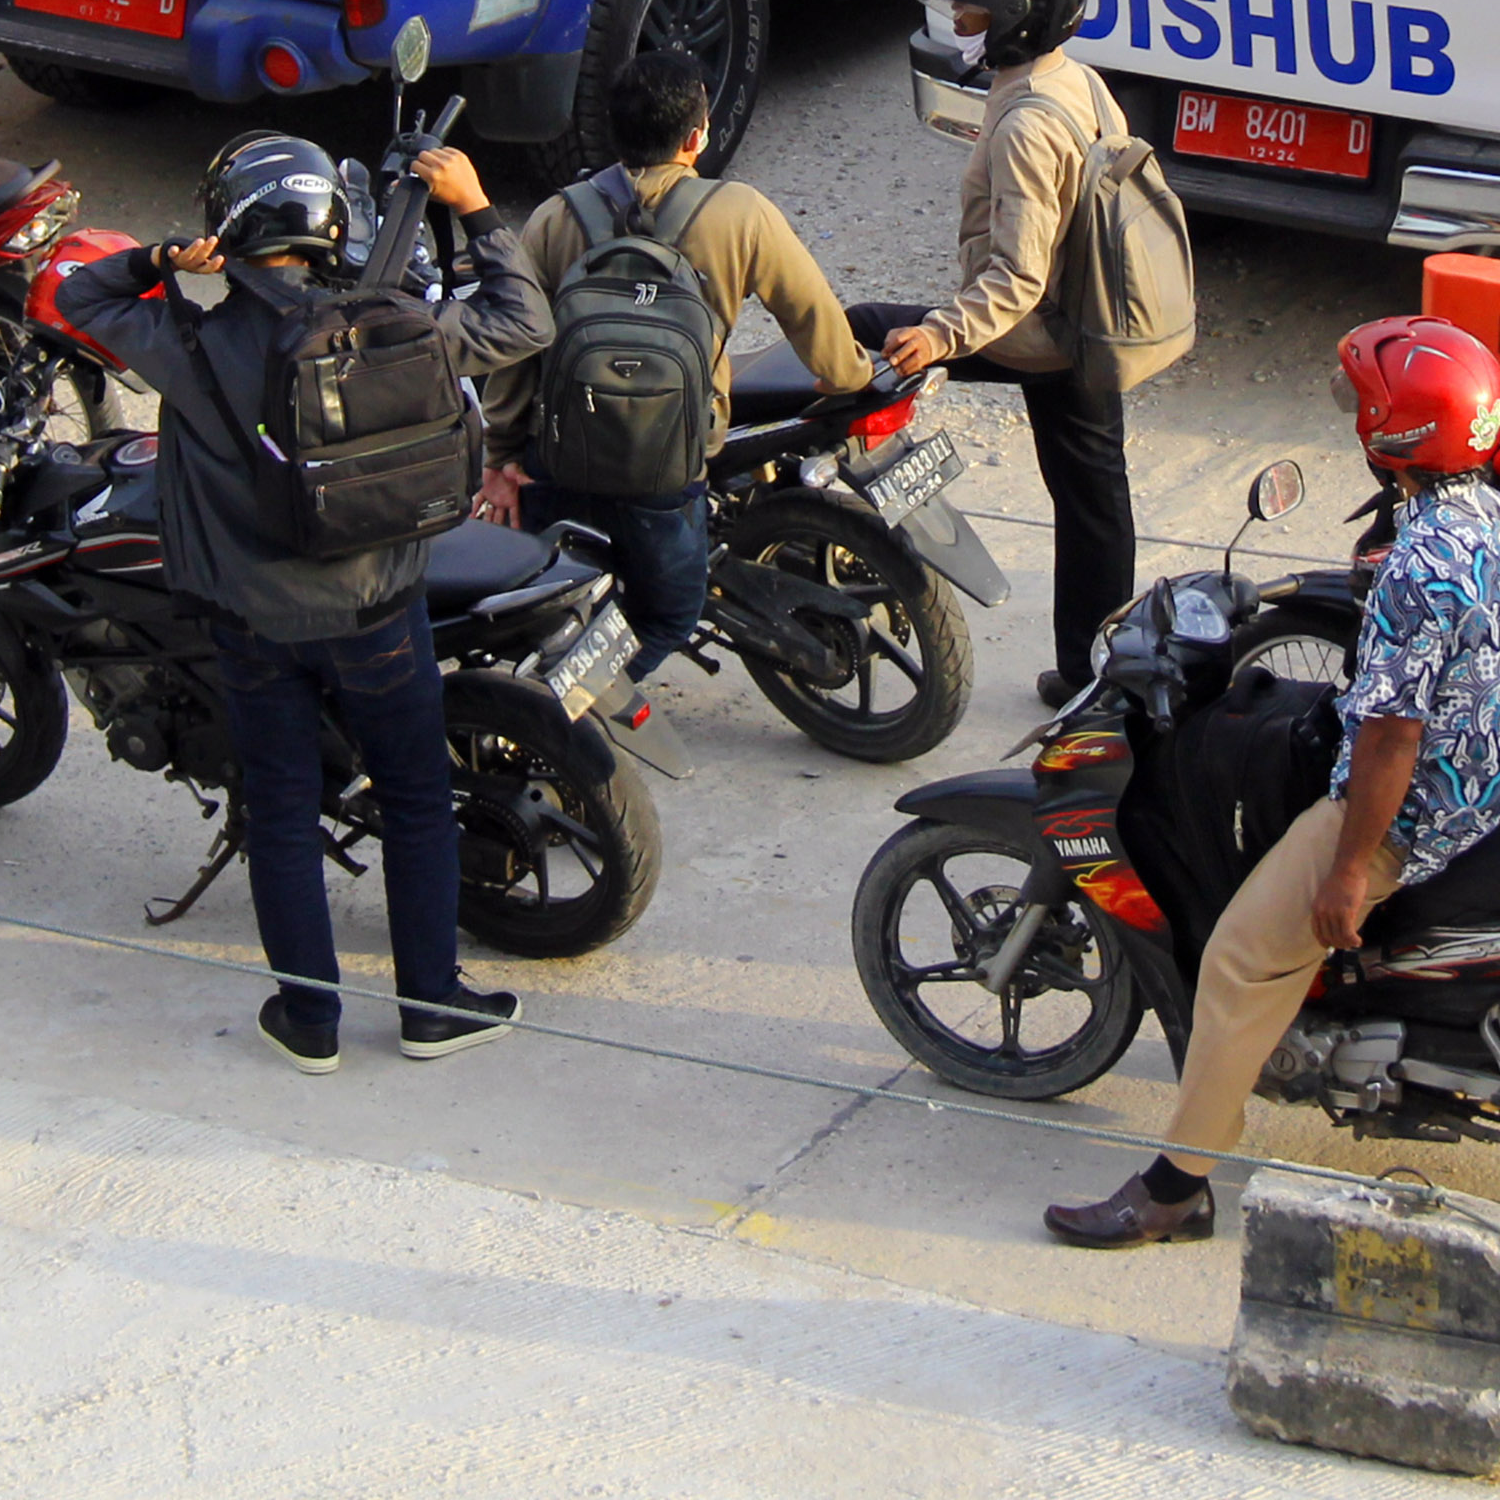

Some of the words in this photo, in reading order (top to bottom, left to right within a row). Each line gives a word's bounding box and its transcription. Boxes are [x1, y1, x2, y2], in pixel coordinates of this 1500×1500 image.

[1180, 95, 1217, 134] BM
[1245, 104, 1307, 147] 8401
[1348, 118, 1366, 155] D
[548, 665, 572, 700] BM
[1053, 835, 1112, 858] YAMAHA
